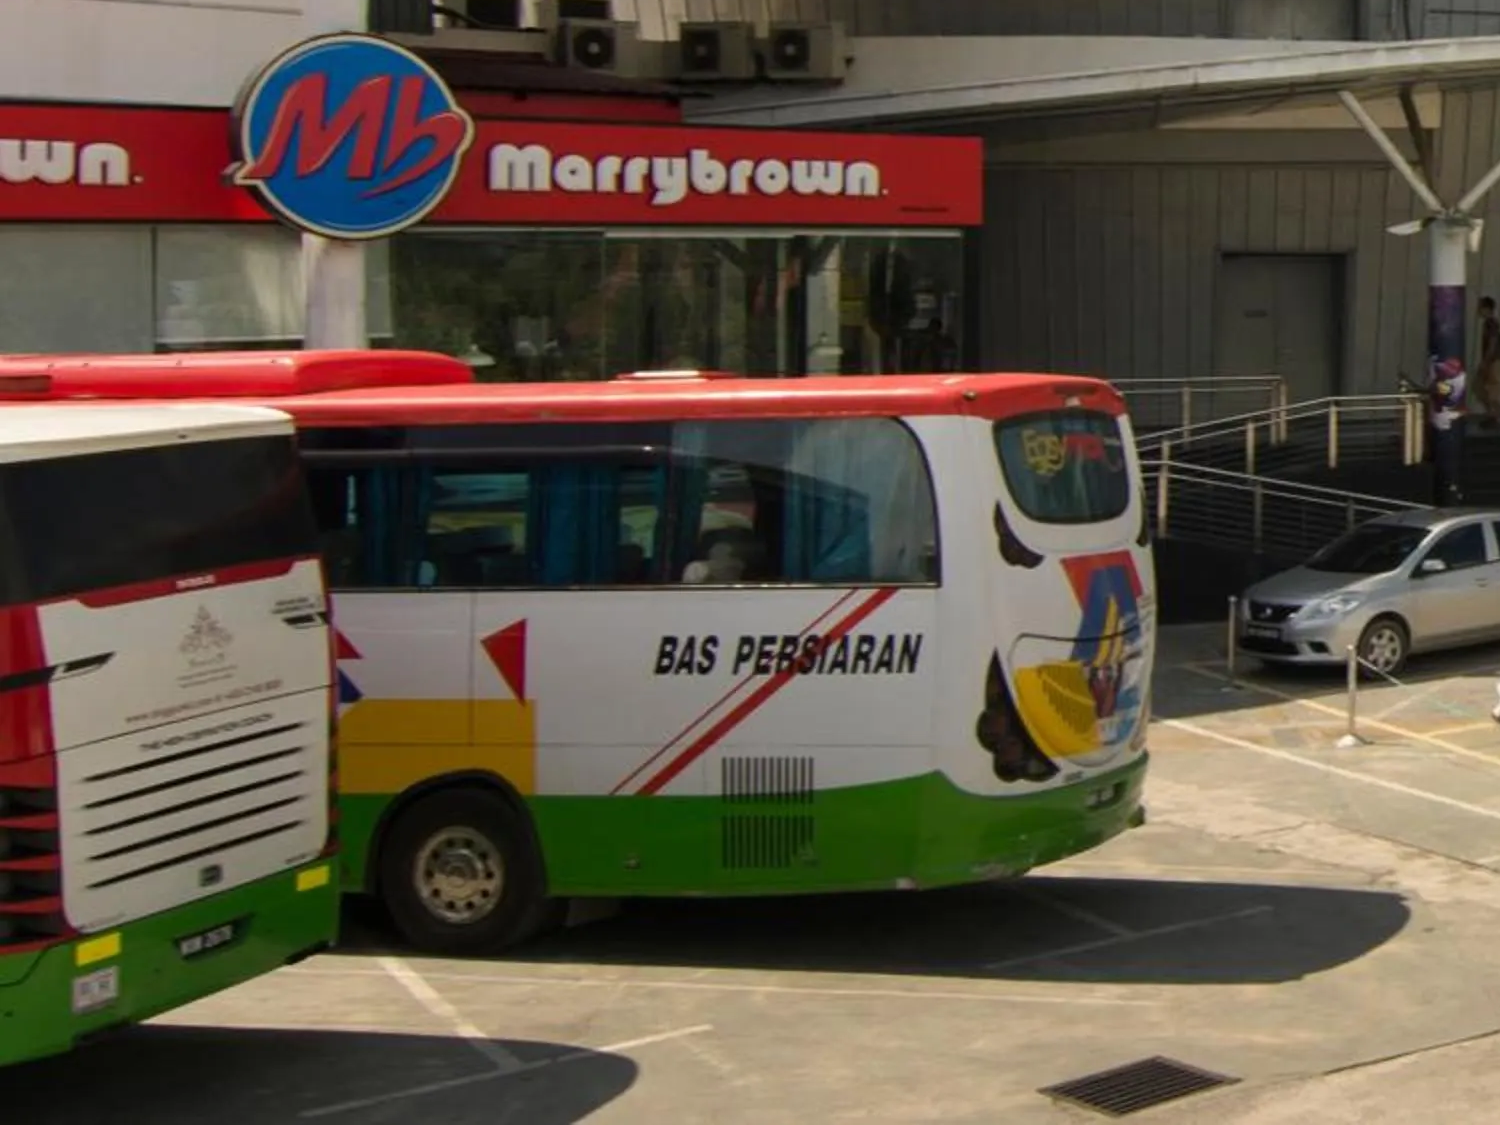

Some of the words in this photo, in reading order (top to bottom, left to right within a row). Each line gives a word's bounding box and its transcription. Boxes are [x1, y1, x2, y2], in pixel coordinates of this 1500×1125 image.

[240, 71, 468, 202] Mb
[653, 633, 719, 677] BAS
[731, 632, 924, 677] PERSIARAN
